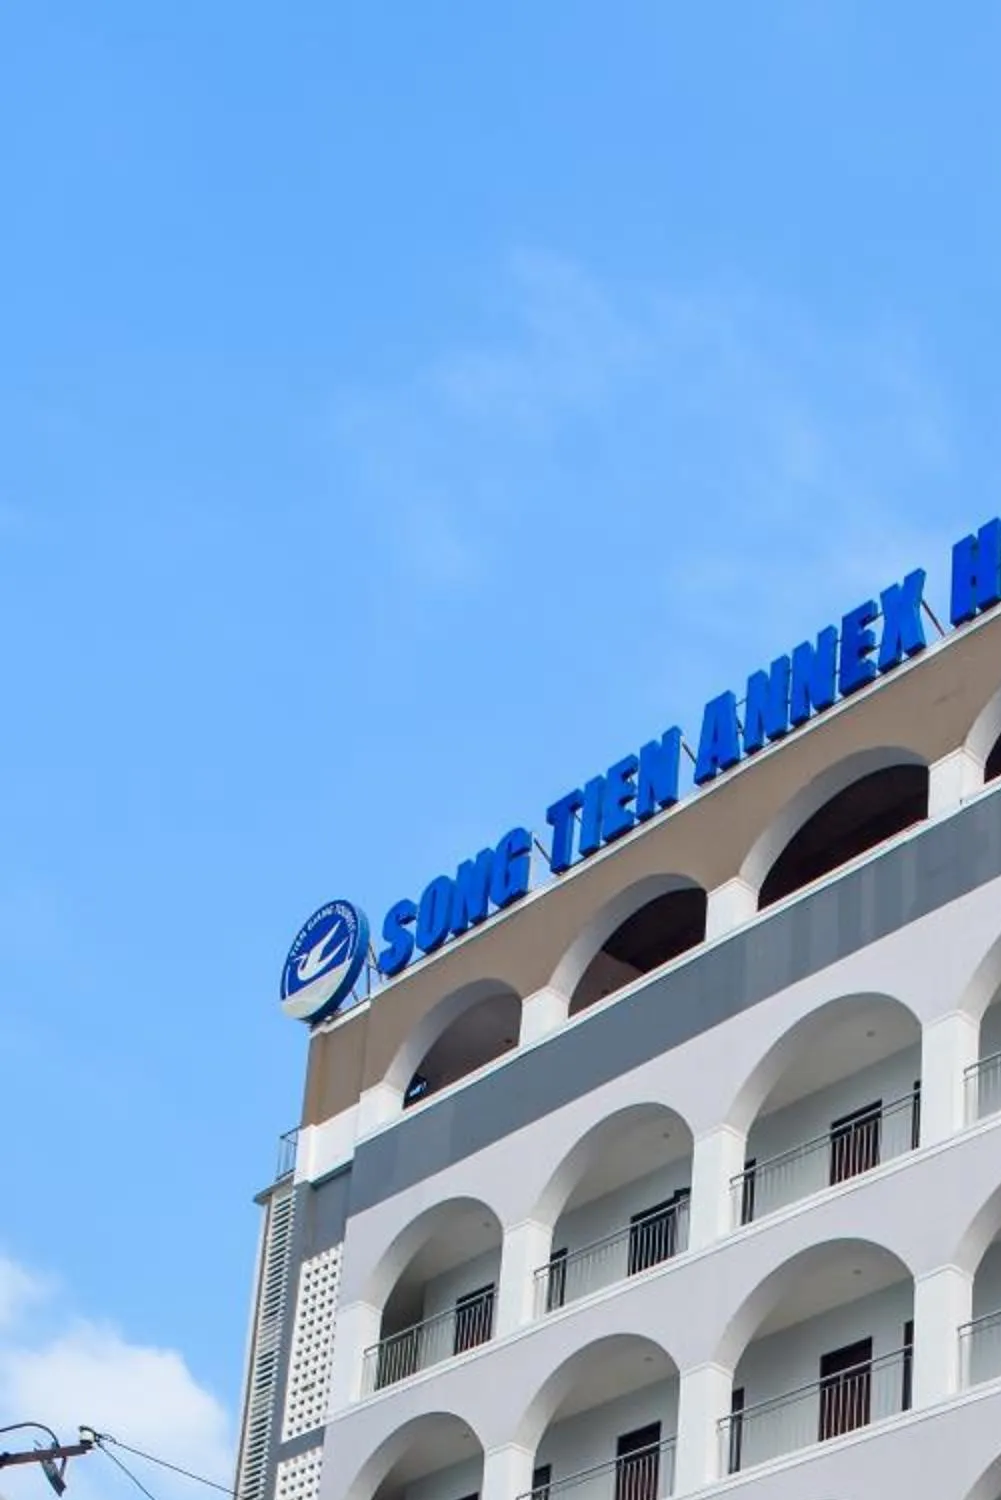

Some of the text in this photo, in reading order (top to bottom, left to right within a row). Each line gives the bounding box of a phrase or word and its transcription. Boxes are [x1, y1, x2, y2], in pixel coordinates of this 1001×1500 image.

[380, 827, 532, 976] SONG
[546, 725, 682, 875] TIEN
[694, 567, 926, 786] ANNEX
